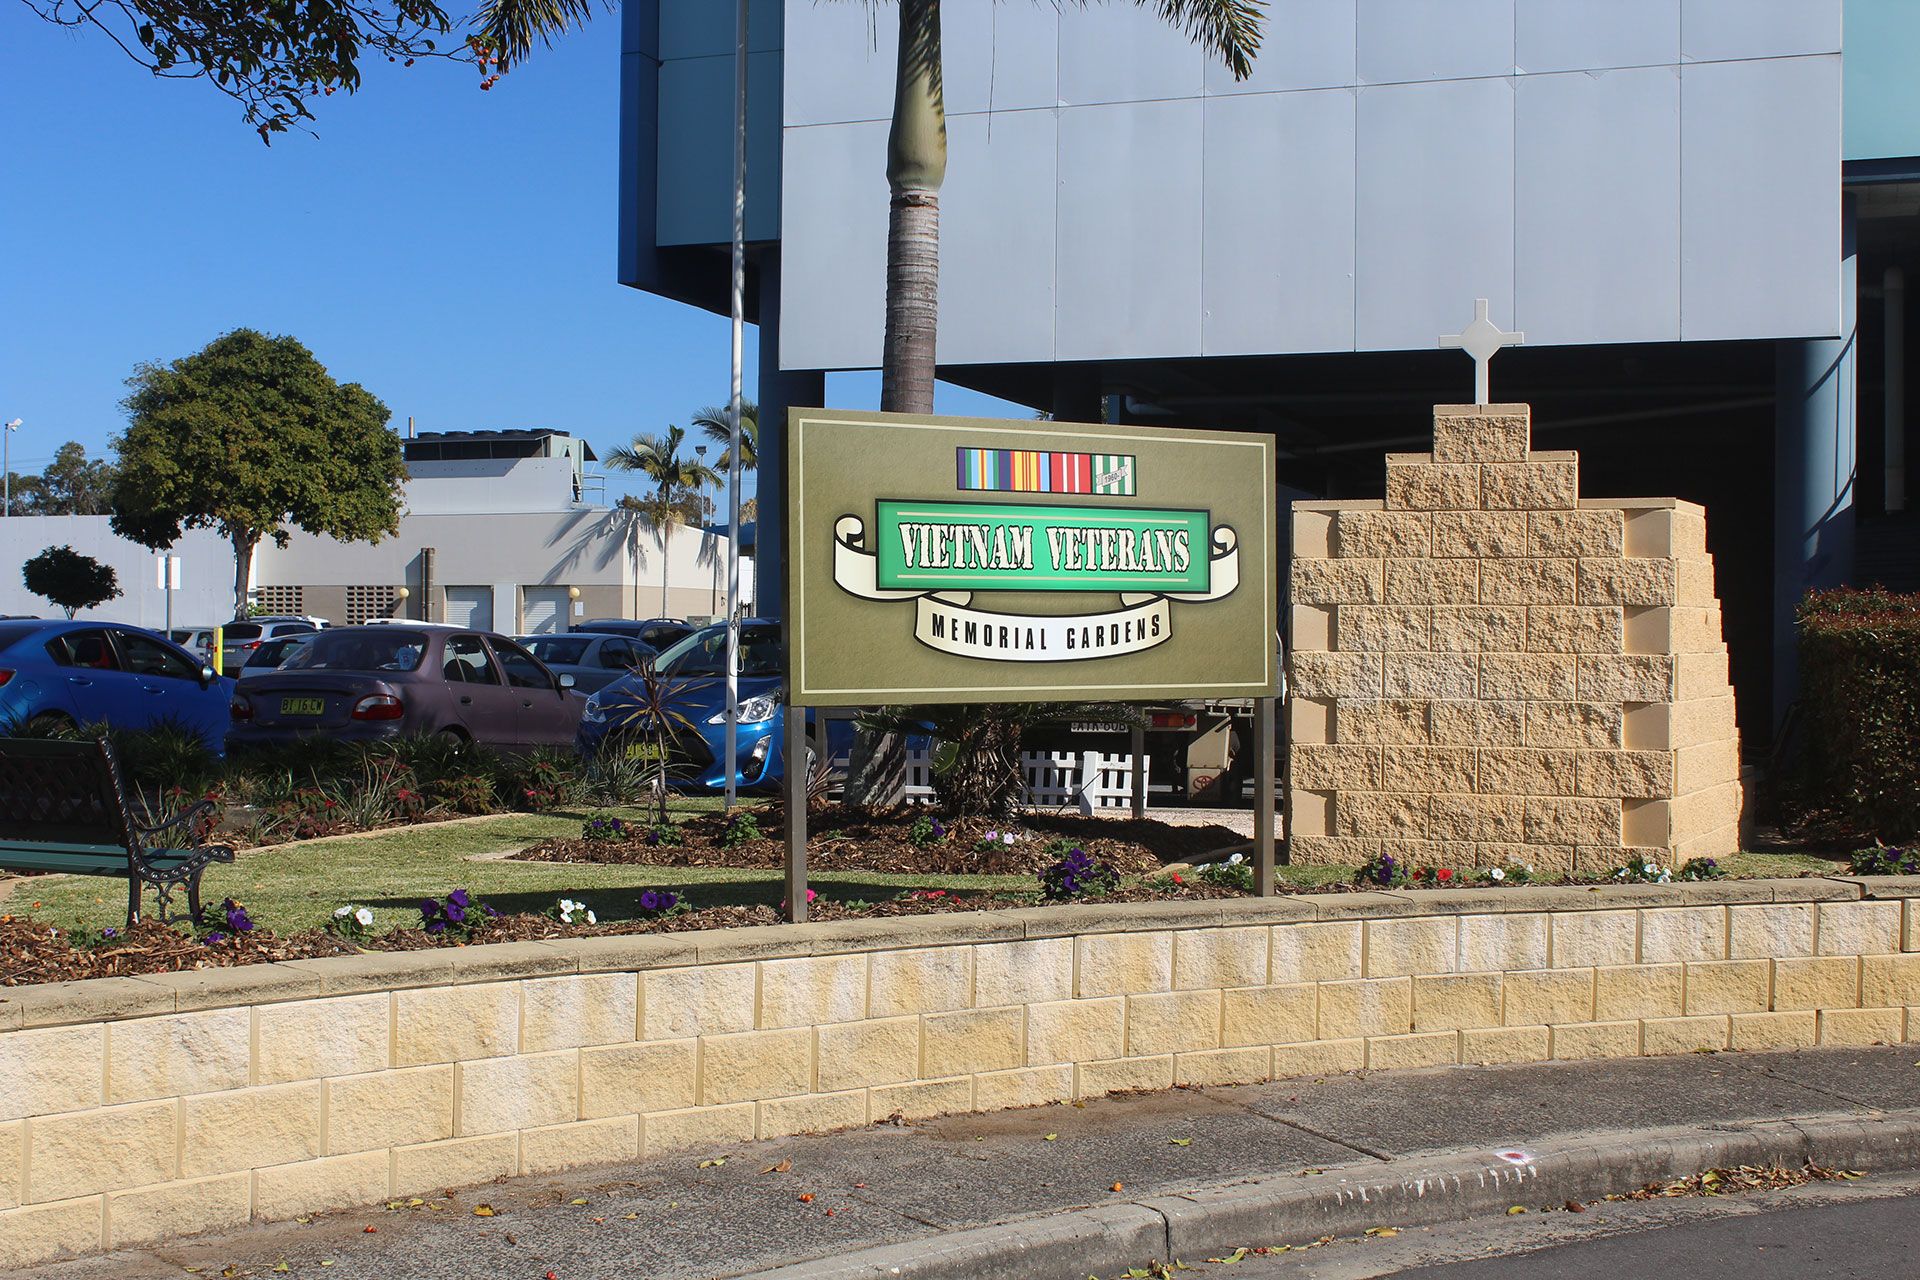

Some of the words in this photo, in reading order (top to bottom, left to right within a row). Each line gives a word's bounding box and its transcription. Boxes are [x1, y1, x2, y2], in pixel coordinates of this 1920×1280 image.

[898, 522, 1034, 570] VIETNAM
[1045, 526, 1190, 573] VETERANS
[931, 613, 1047, 650] MEMORIAL
[1066, 614, 1160, 650] GARDENS
